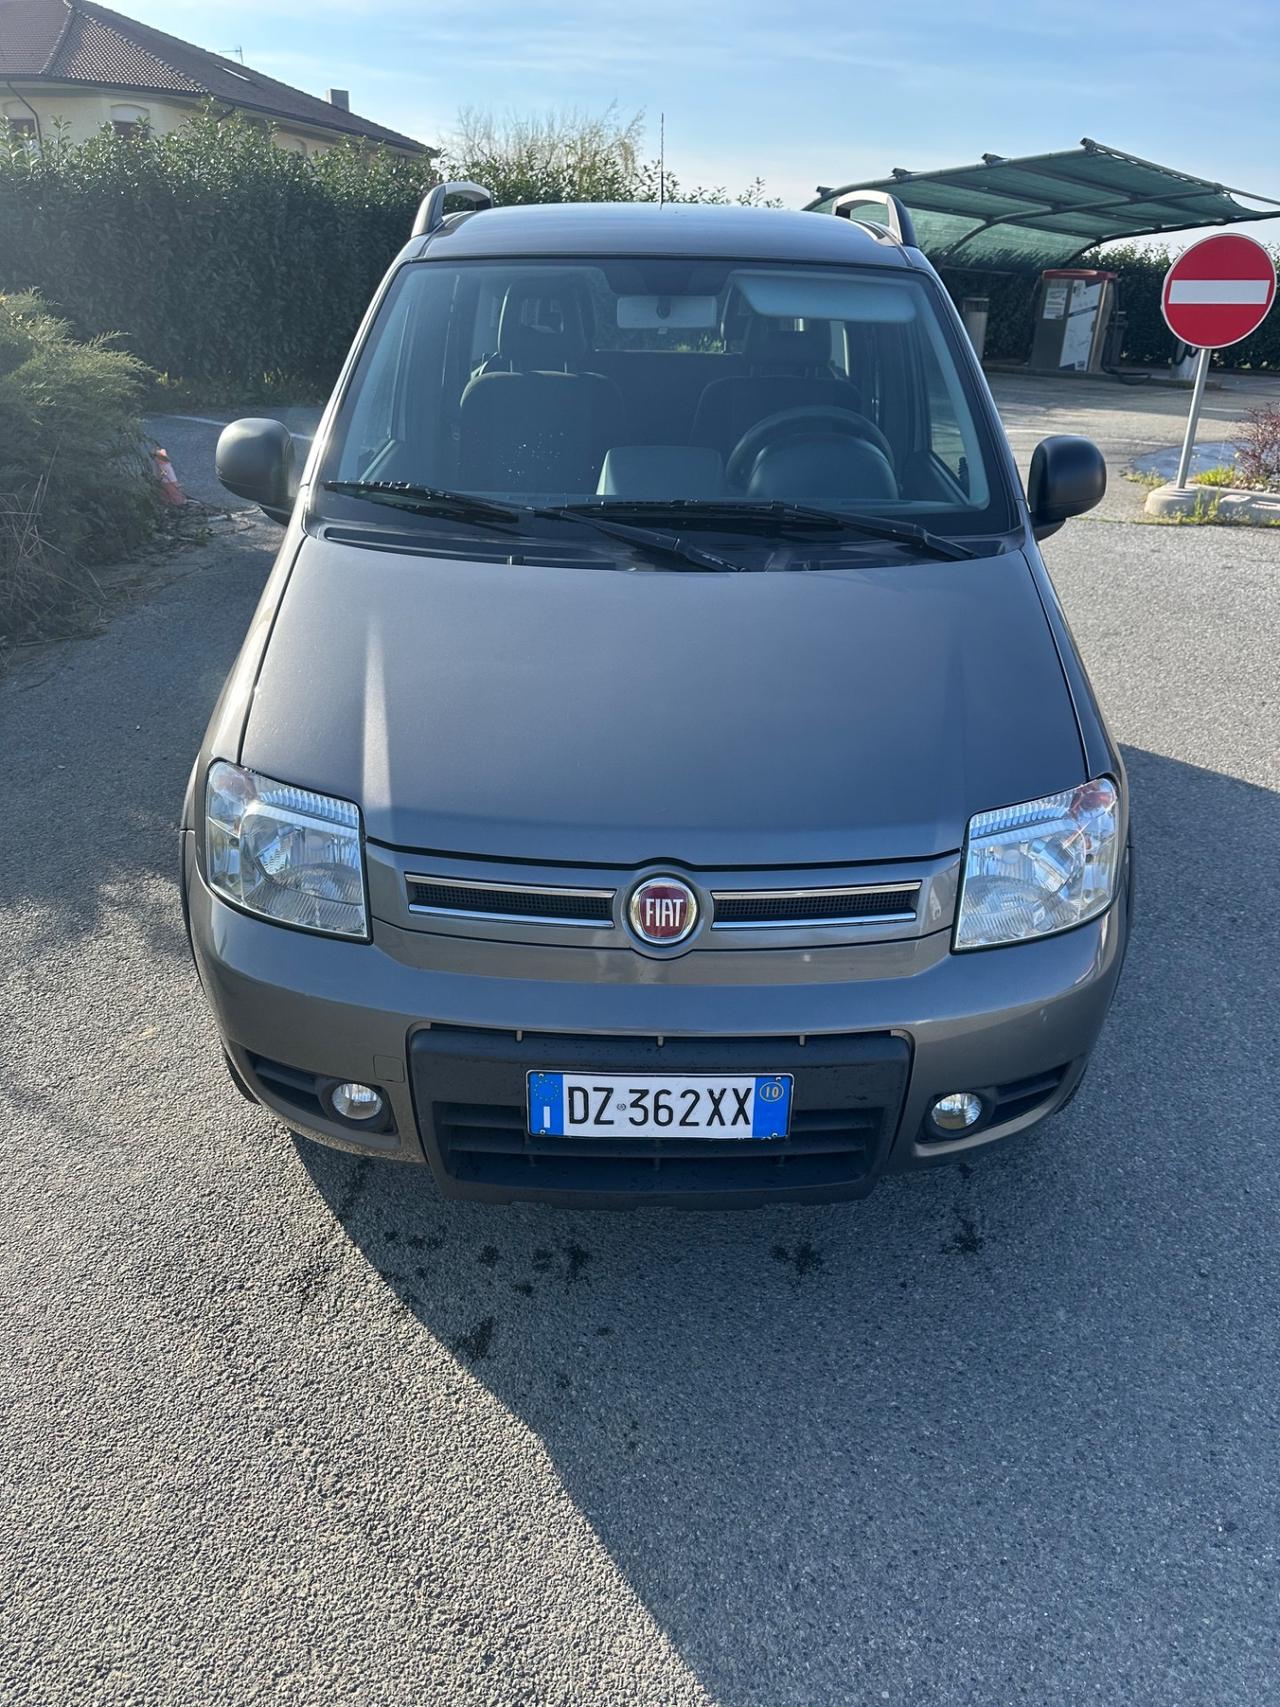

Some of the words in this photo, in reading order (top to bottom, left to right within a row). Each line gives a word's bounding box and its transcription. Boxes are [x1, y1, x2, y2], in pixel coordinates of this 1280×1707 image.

[646, 899, 684, 927] FIAT
[568, 1086, 614, 1125] DZ
[629, 1088, 752, 1126] 362XX
[764, 1087, 779, 1098] 10
